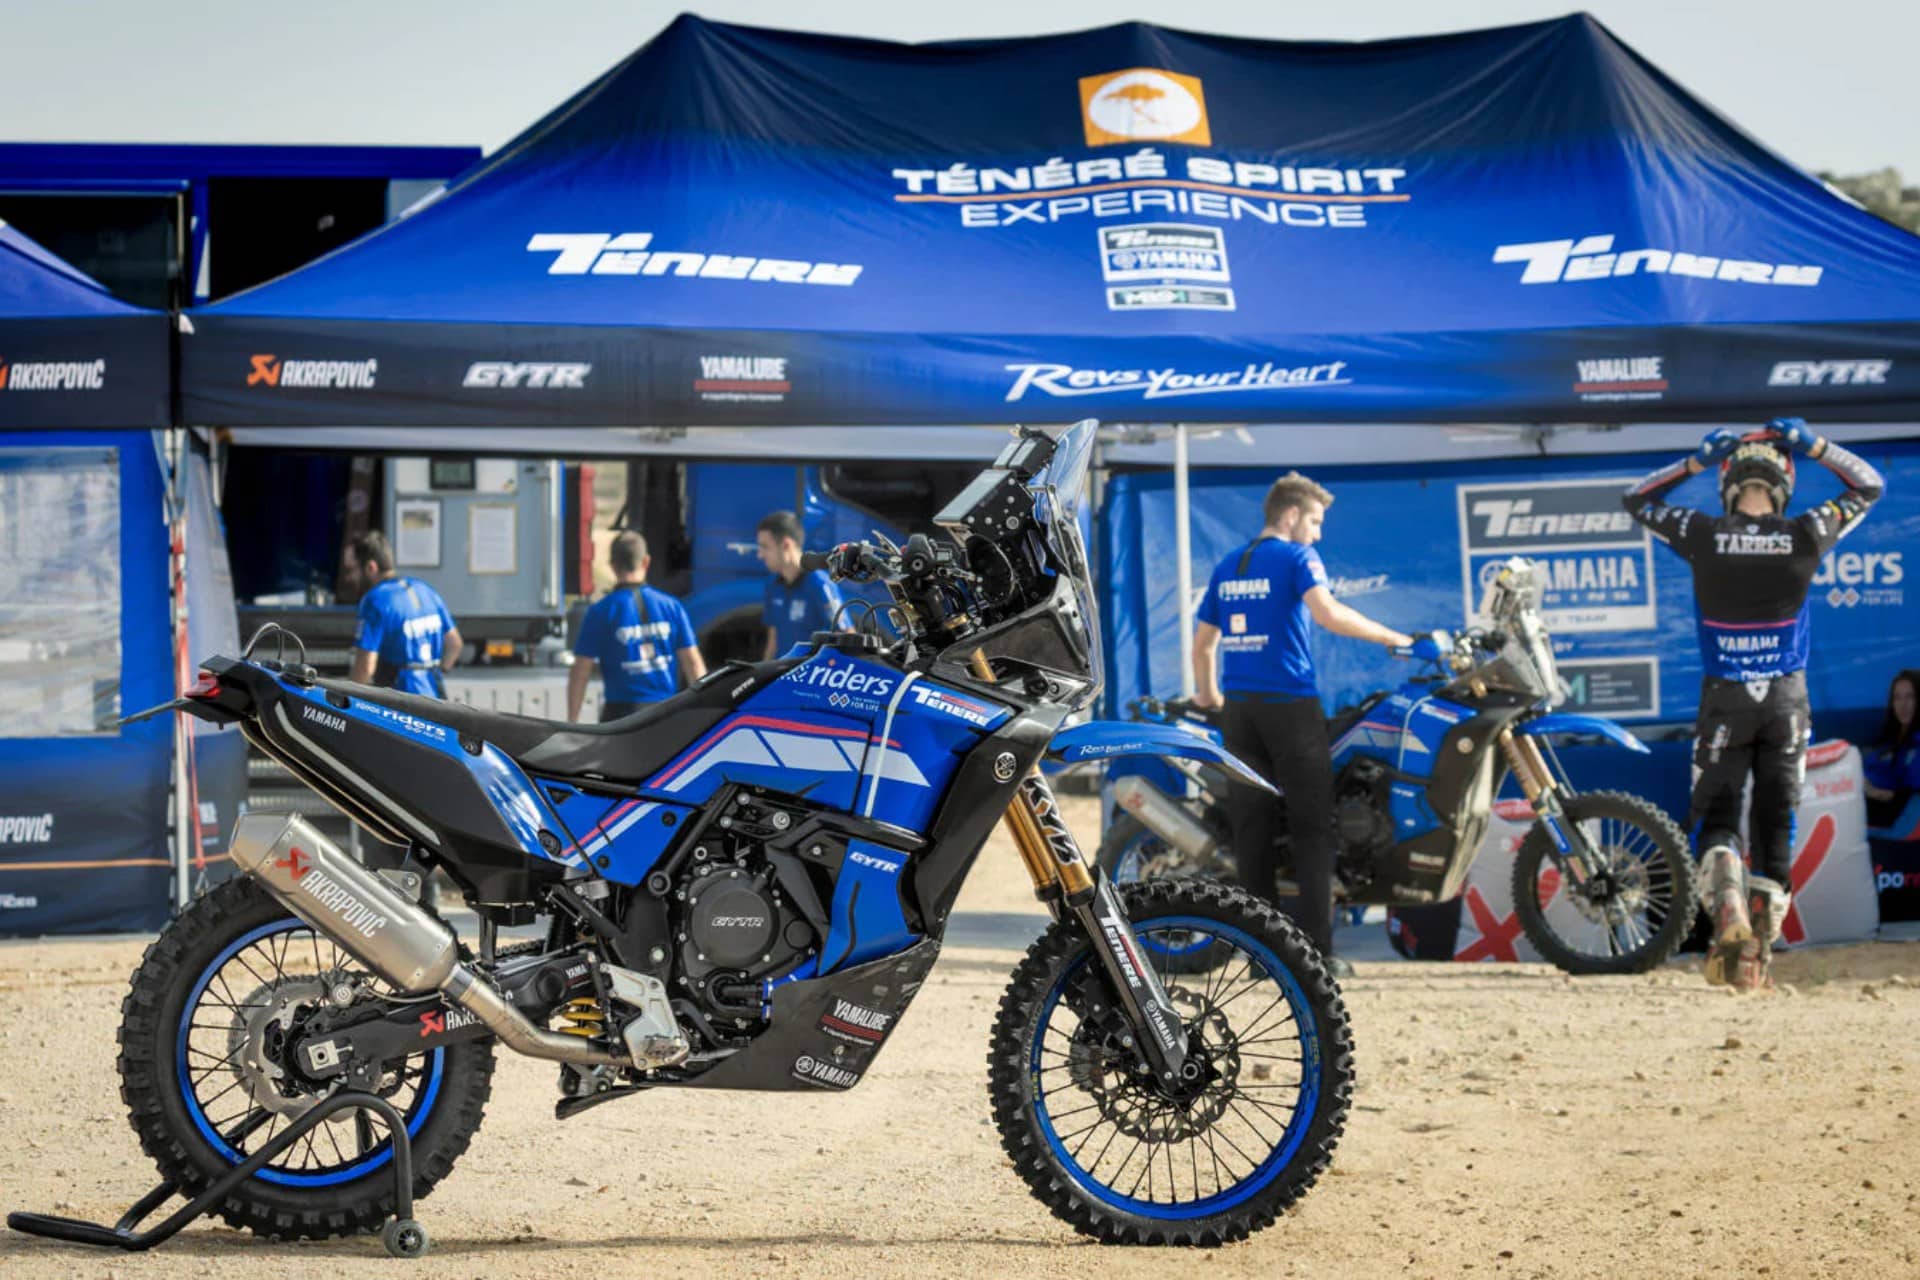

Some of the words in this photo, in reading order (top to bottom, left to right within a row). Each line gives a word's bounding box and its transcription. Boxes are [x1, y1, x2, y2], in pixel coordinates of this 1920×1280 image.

[892, 148, 1167, 195] TÉNÉRÉ
[1187, 157, 1408, 193] SPIRIT
[961, 189, 1367, 228] EXPERIENCE
[462, 361, 592, 388] GYTR
[700, 356, 788, 381] YAMALUBE
[1005, 363, 1144, 401] Revs
[1243, 361, 1352, 388] Heart
[1577, 357, 1664, 383] YAMALUBE
[1767, 359, 1893, 386] GYTR
[1533, 556, 1639, 589] AMAHA
[807, 658, 895, 696] riders
[302, 704, 347, 733] YAMAHA
[383, 709, 446, 736] riders
[849, 851, 900, 874] GYTR
[711, 915, 764, 928] GYTR
[833, 998, 892, 1032] YAMALUBE
[1152, 1010, 1176, 1050] YAMAHA
[811, 1061, 859, 1088] YAMAHA
